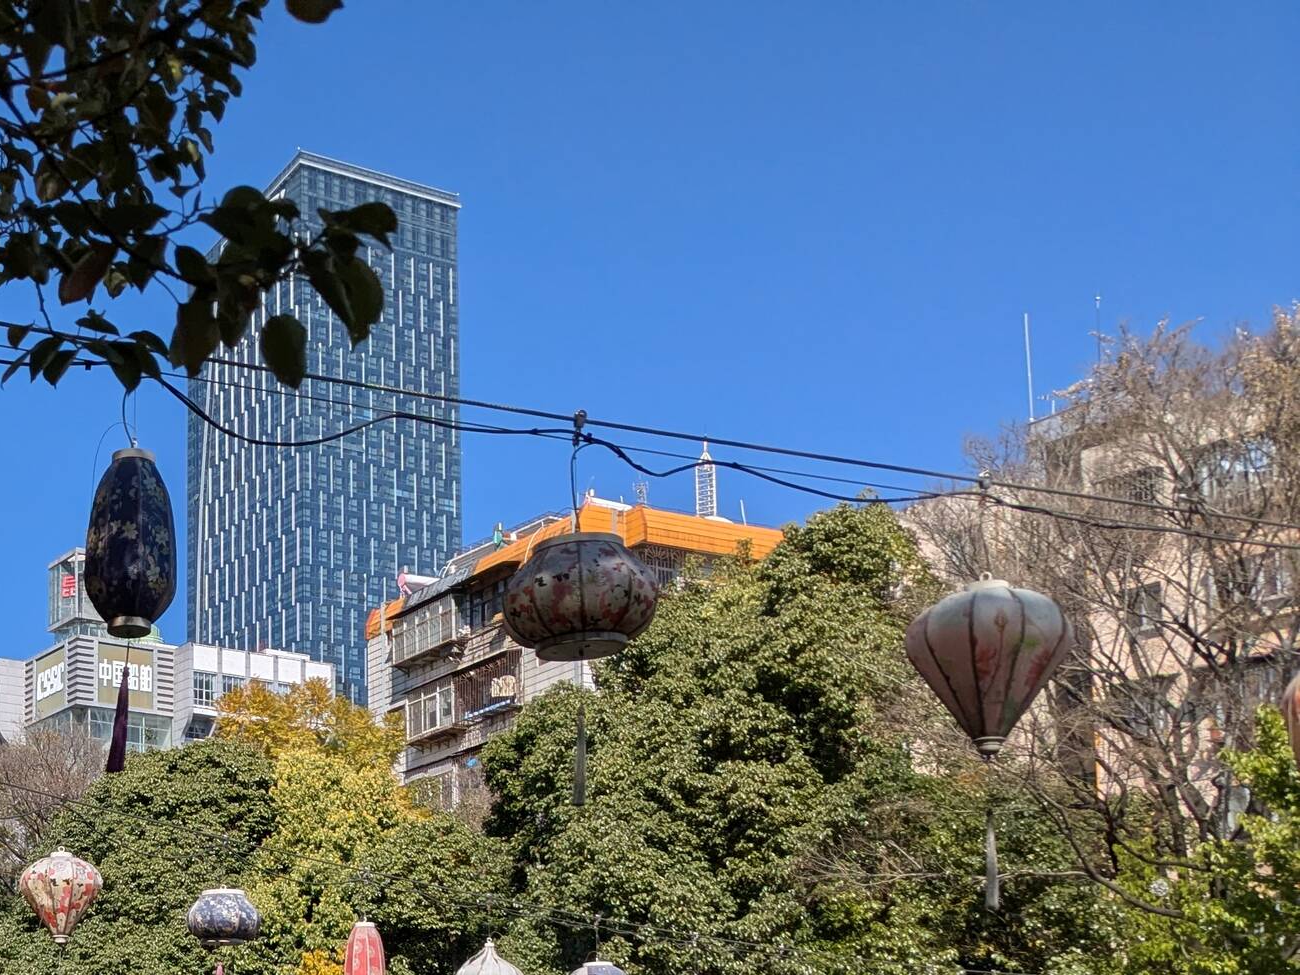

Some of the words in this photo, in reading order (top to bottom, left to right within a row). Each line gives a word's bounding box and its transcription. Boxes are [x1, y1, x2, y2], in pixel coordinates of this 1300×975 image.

[36, 661, 65, 701] CSSC
[99, 659, 153, 692] 中国船舶
